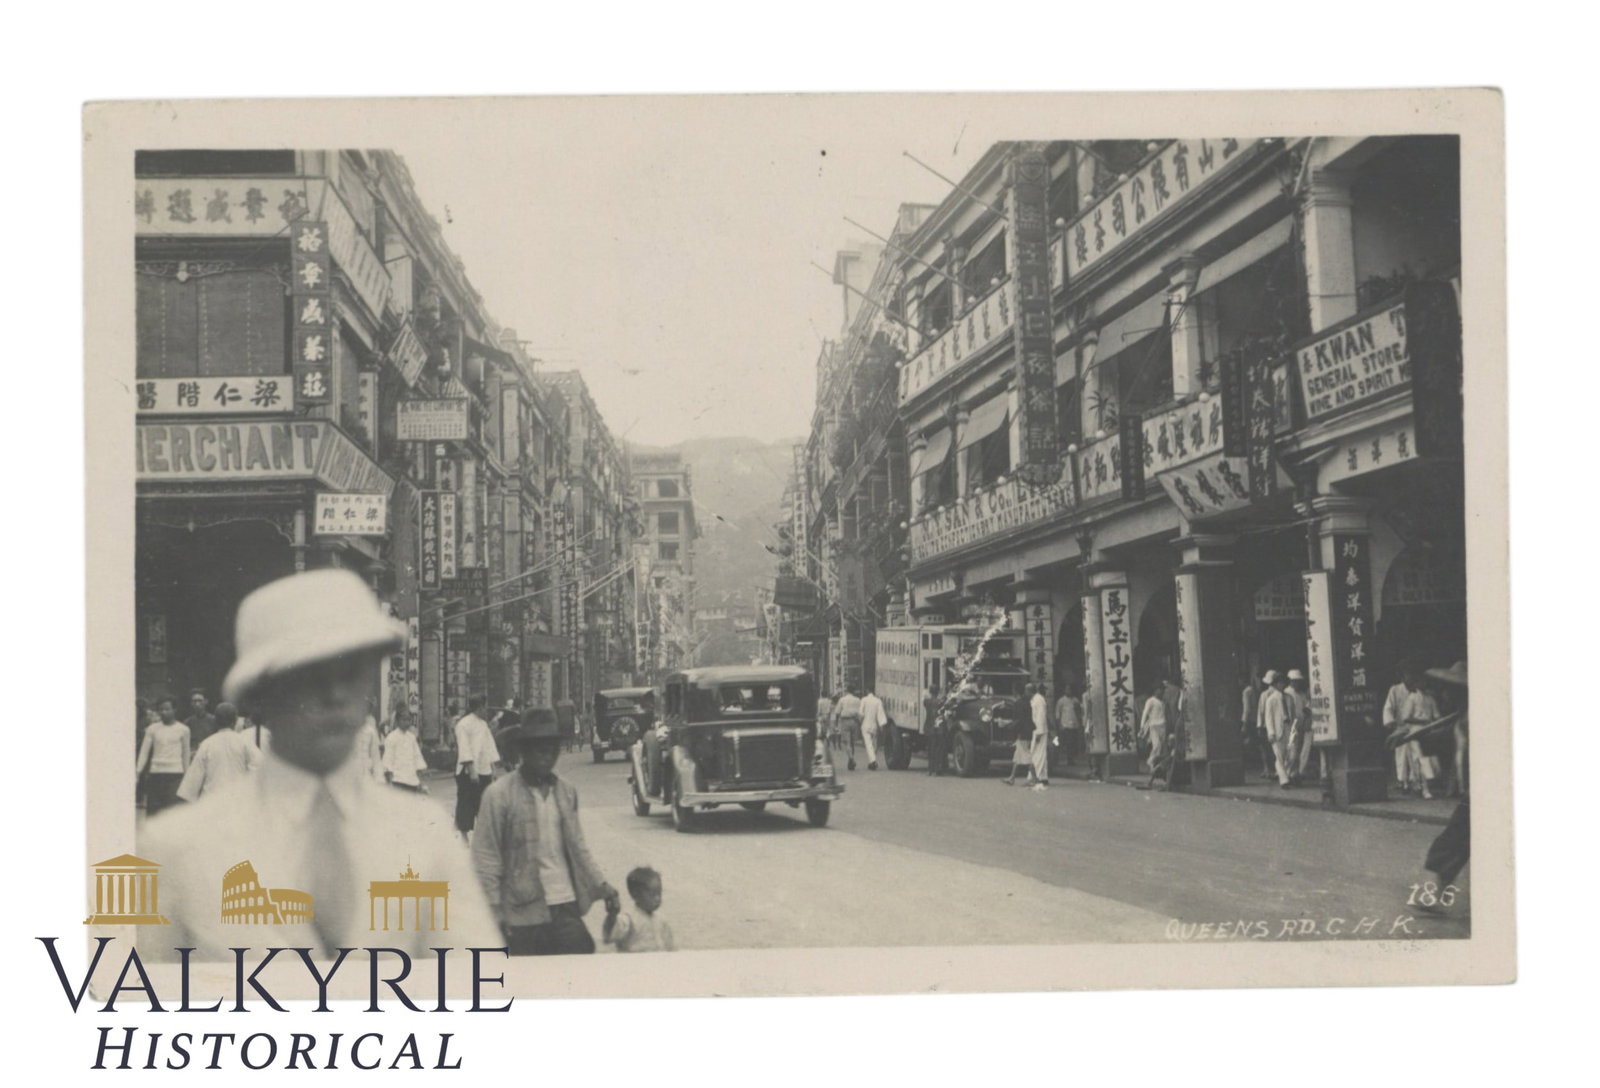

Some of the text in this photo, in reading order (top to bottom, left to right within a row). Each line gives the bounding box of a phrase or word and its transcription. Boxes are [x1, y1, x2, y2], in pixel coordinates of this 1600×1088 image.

[1314, 322, 1376, 372] KWAN
[1306, 364, 1358, 398] GENERAL
[1358, 371, 1394, 398] SPIRIT
